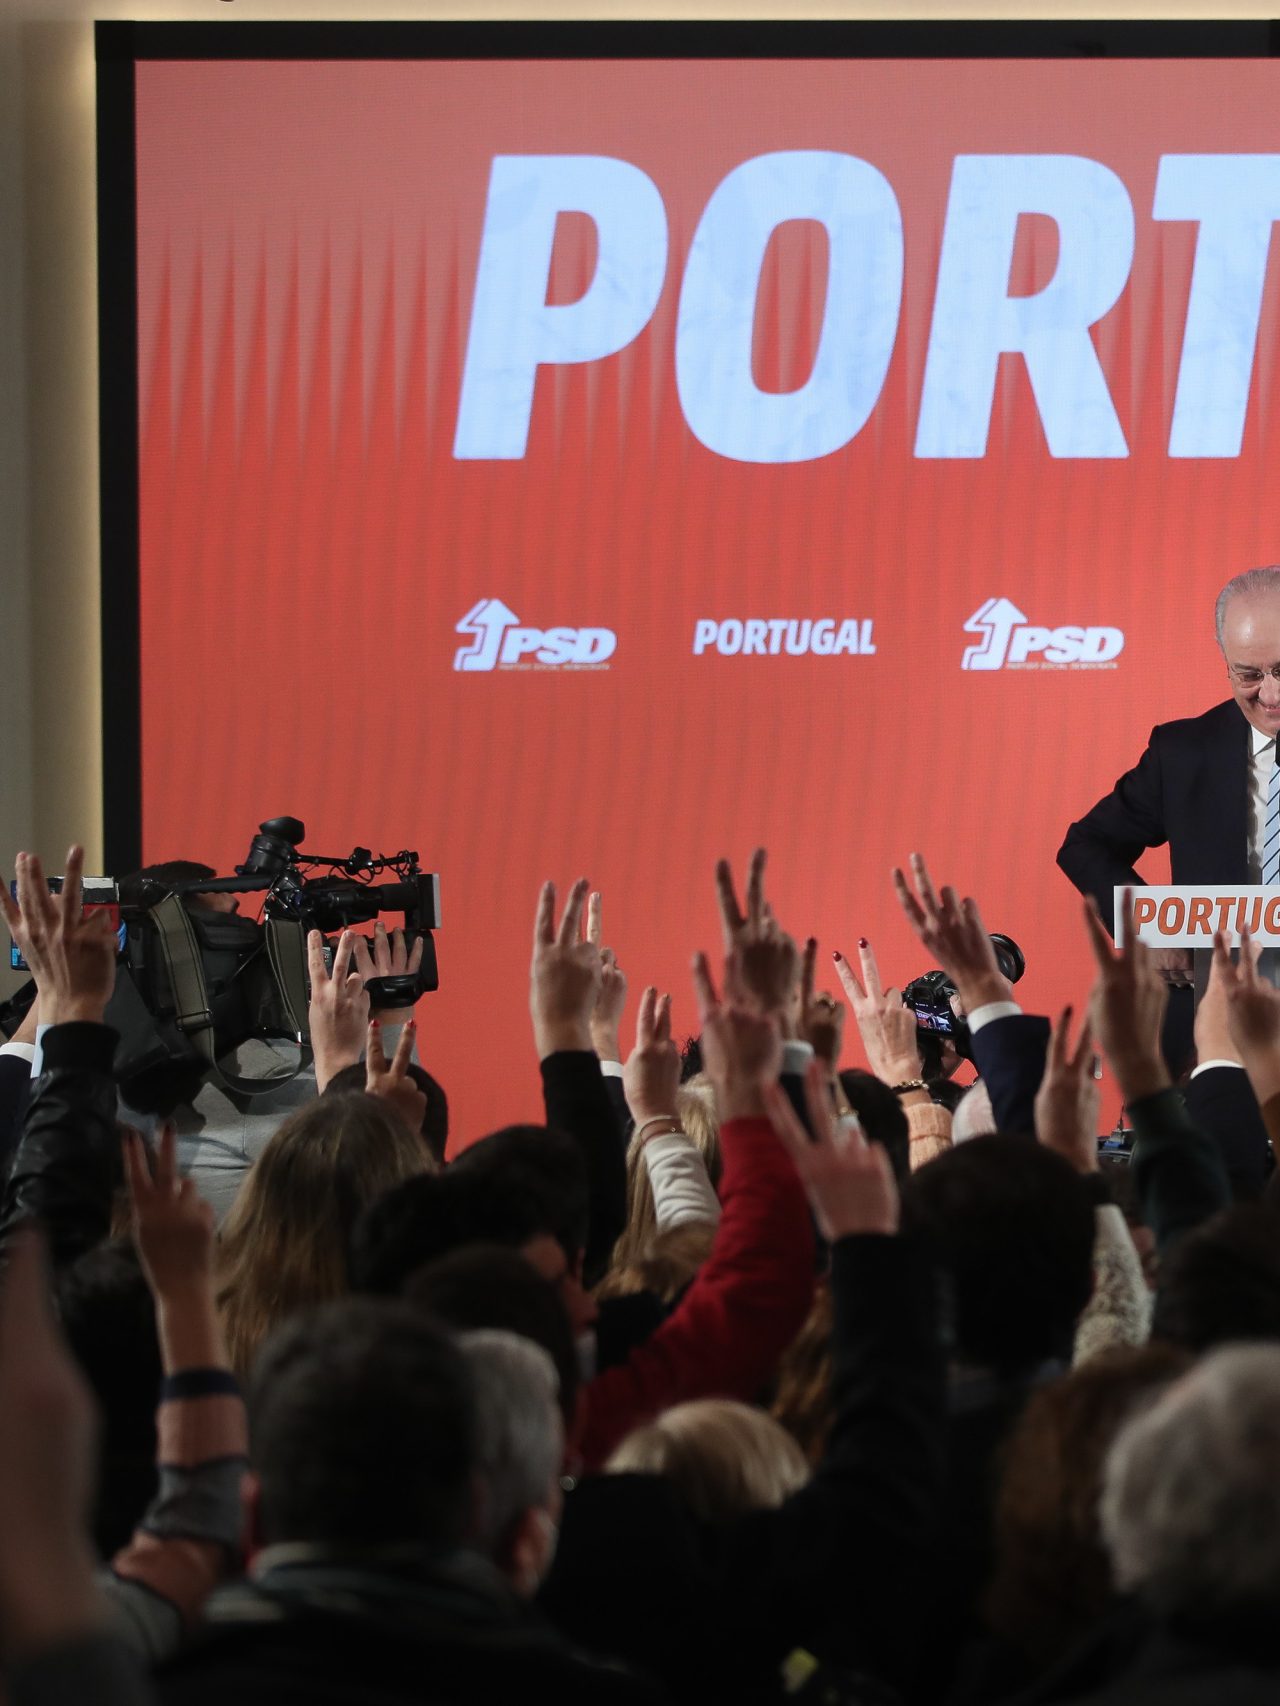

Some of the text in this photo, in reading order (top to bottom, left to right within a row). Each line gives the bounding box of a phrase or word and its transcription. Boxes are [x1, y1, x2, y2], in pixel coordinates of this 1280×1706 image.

[500, 627, 617, 664] PSD
[693, 618, 877, 655] PORTUGAL
[1007, 626, 1125, 664] PSD
